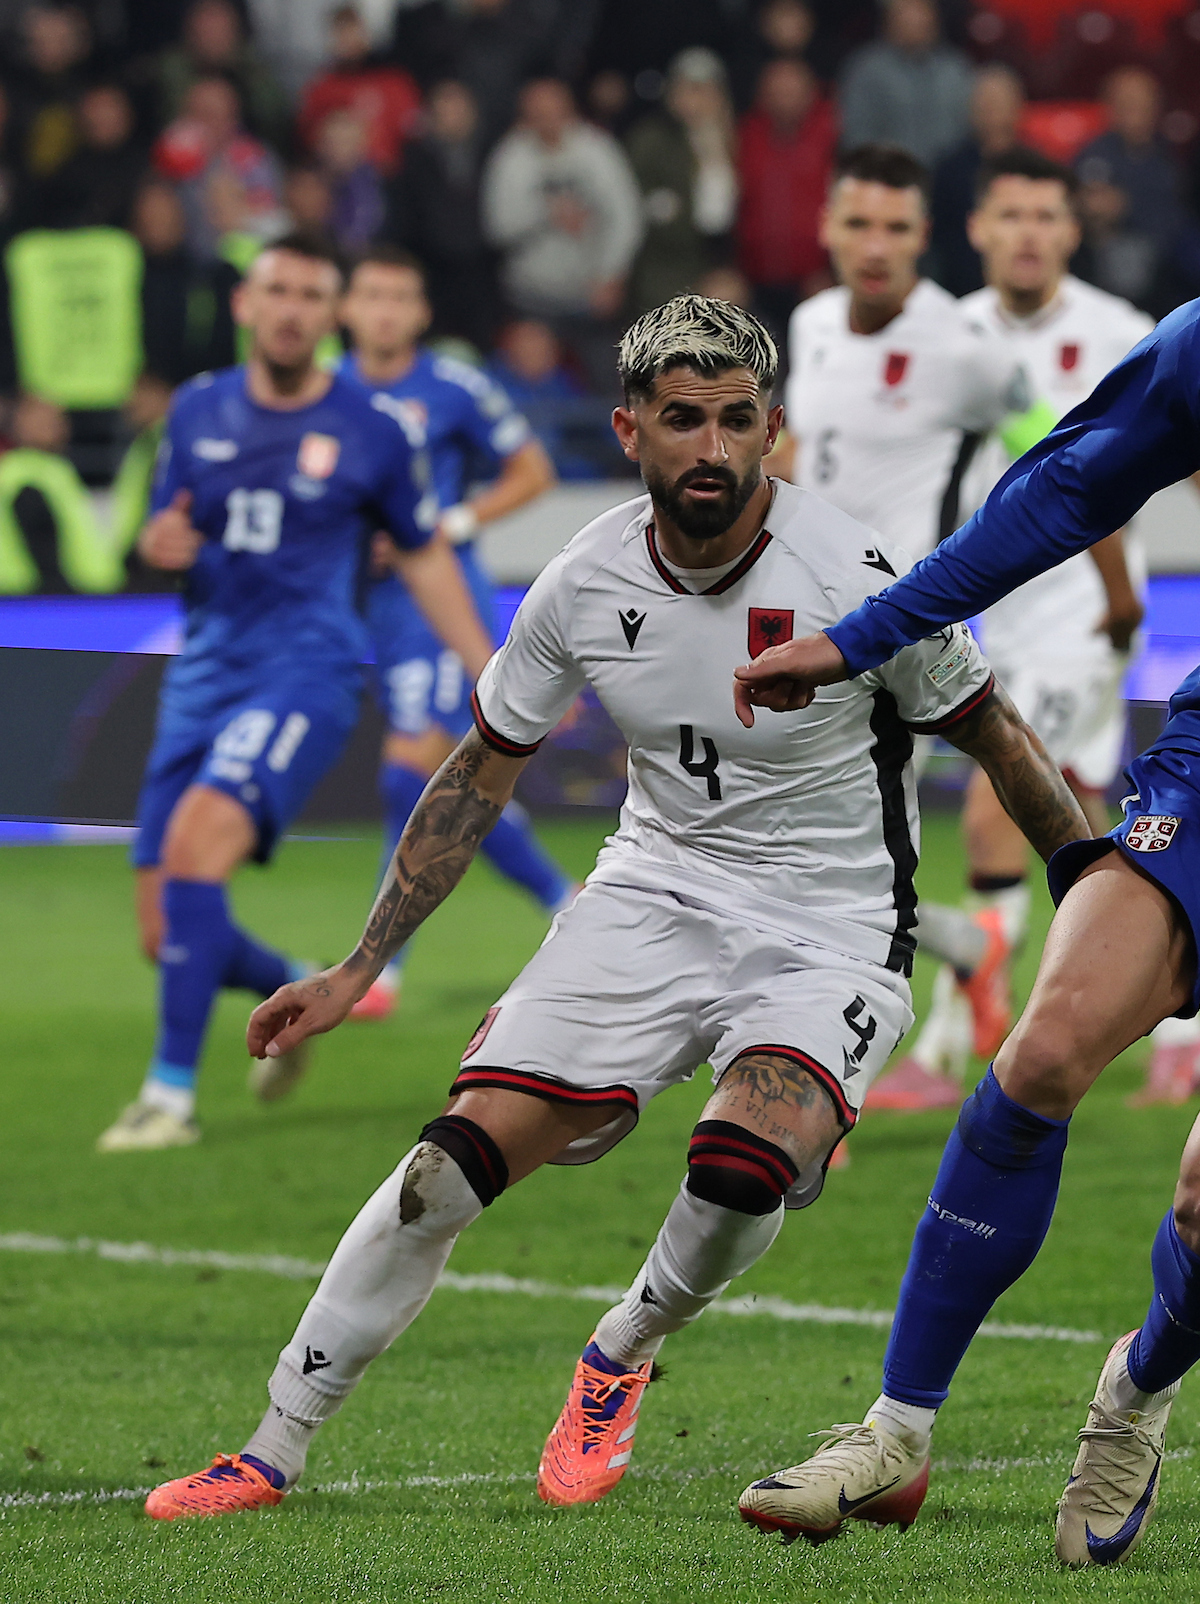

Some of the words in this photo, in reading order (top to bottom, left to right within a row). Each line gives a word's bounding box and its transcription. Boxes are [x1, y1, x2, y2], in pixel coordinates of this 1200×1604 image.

[222, 487, 285, 555] 13
[678, 724, 723, 801] 4
[842, 994, 878, 1063] 4
